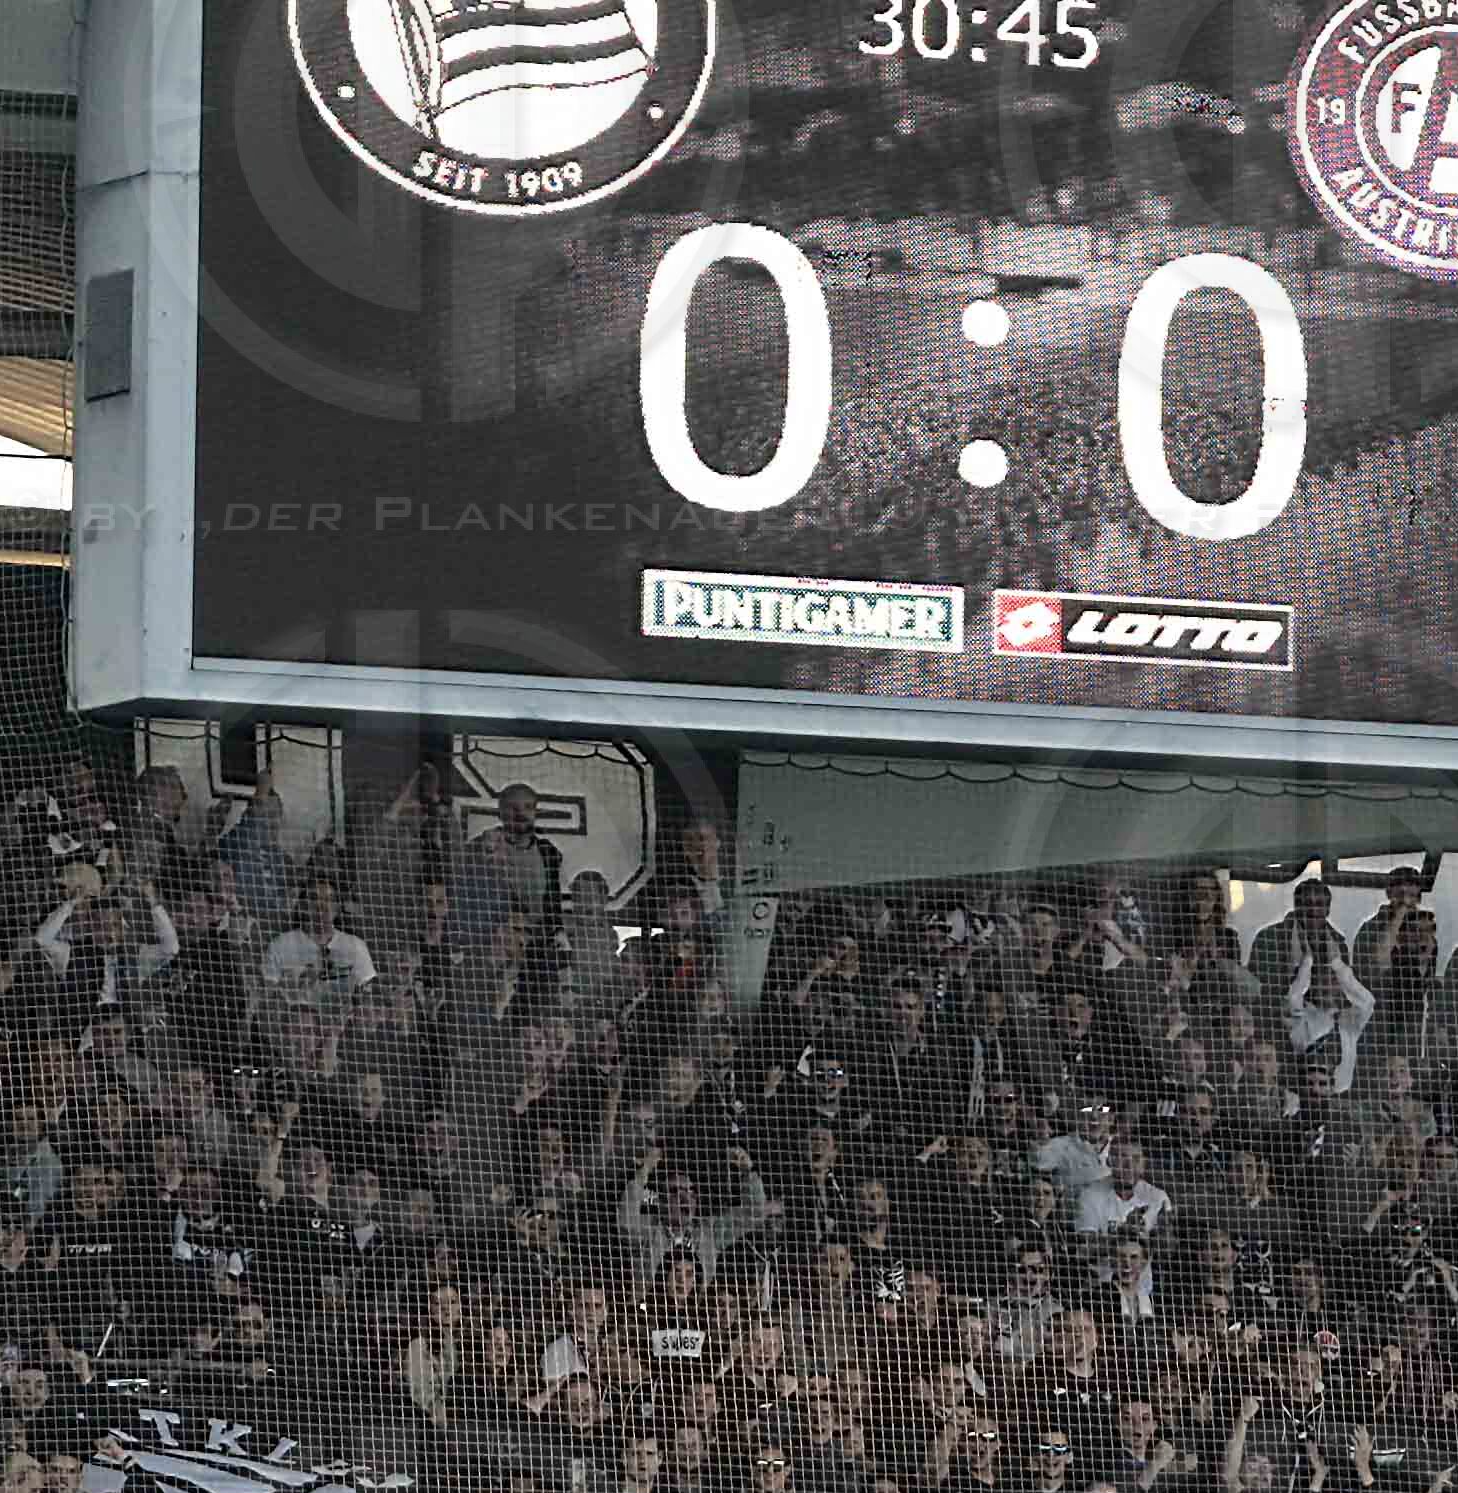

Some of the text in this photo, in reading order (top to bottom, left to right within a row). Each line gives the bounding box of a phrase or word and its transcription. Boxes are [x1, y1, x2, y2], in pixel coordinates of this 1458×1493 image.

[859, 0, 1099, 69] 30:45
[412, 151, 583, 198] SEIT 1909
[660, 578, 944, 641] PUNTIGAMER
[1065, 609, 1284, 655] LOTTO
